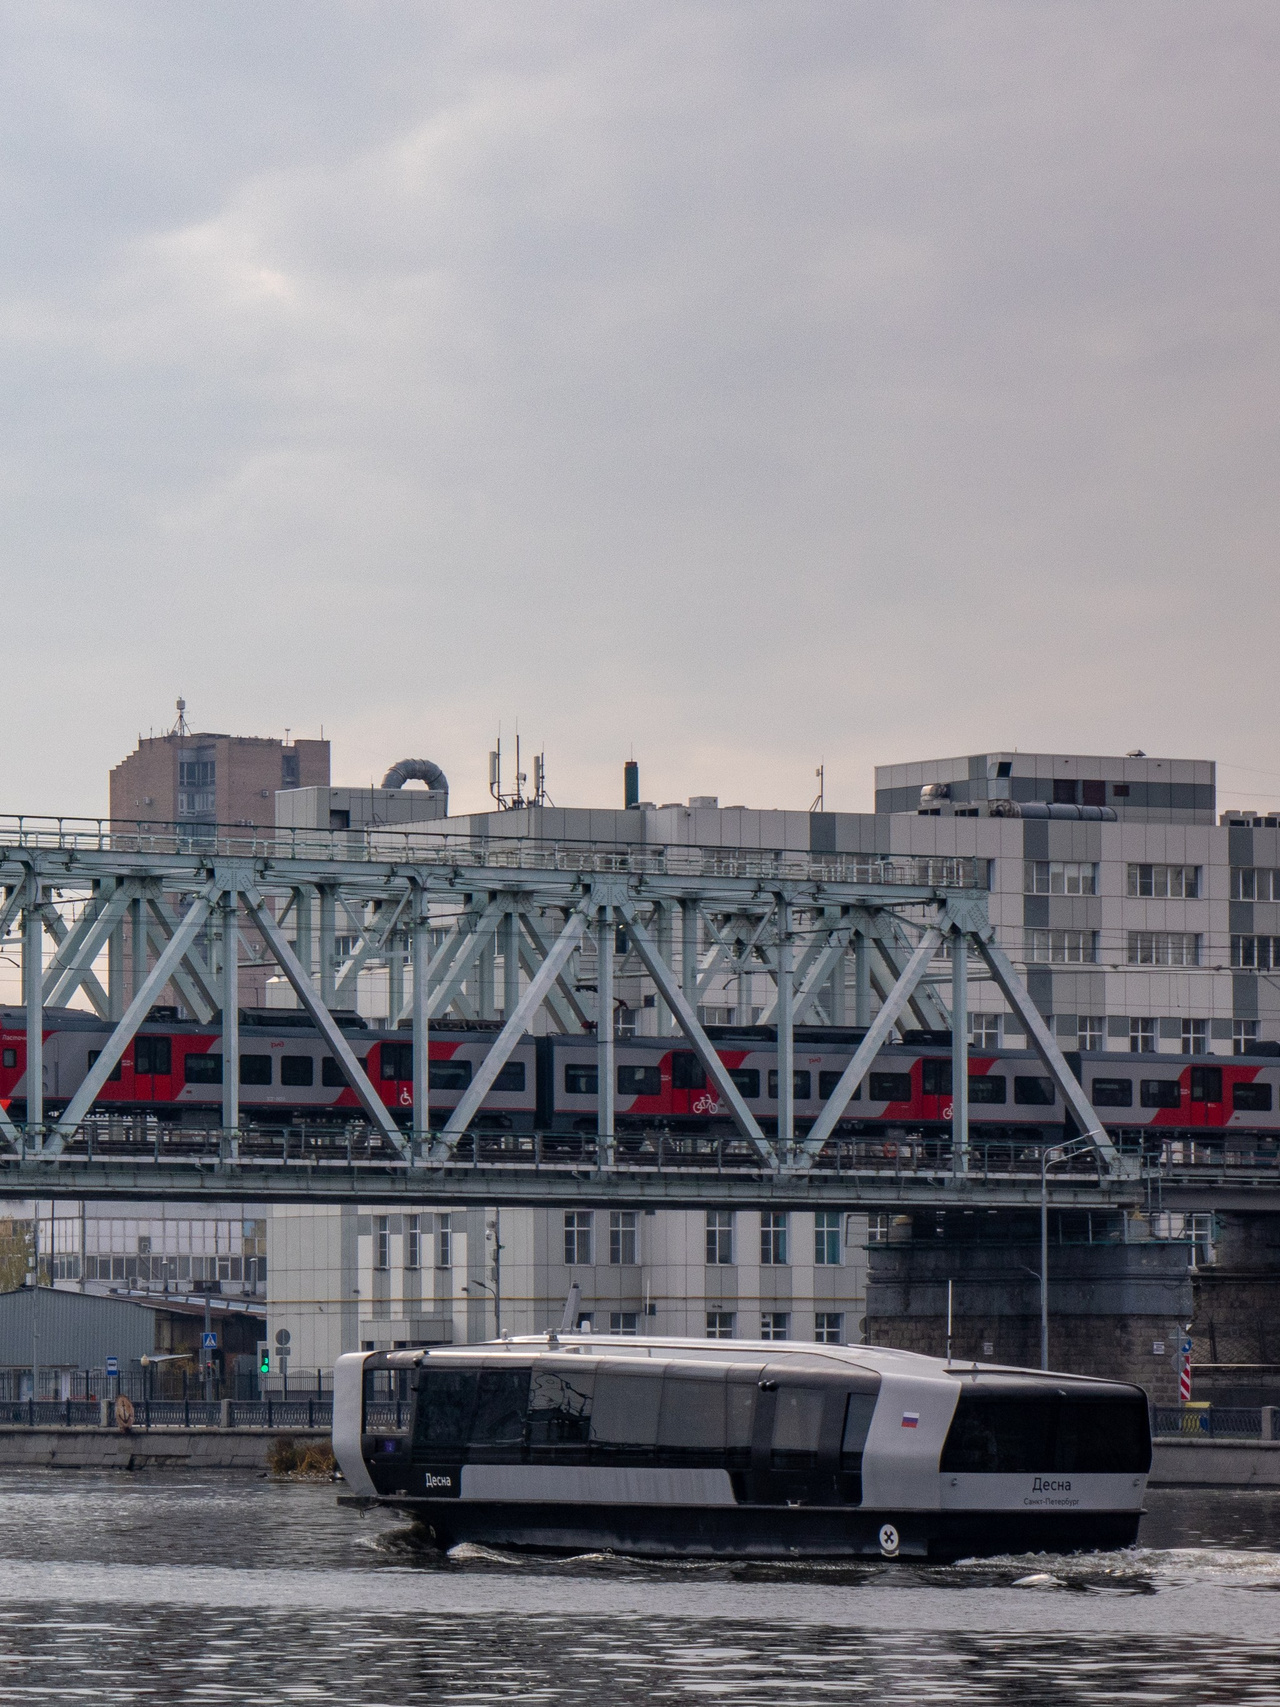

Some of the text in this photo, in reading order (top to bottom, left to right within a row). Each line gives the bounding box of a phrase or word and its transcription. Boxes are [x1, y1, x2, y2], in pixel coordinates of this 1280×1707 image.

[425, 1472, 452, 1488] Десна
[1032, 1477, 1071, 1493] Десна
[1023, 1497, 1080, 1507] Санкт-Петербург
